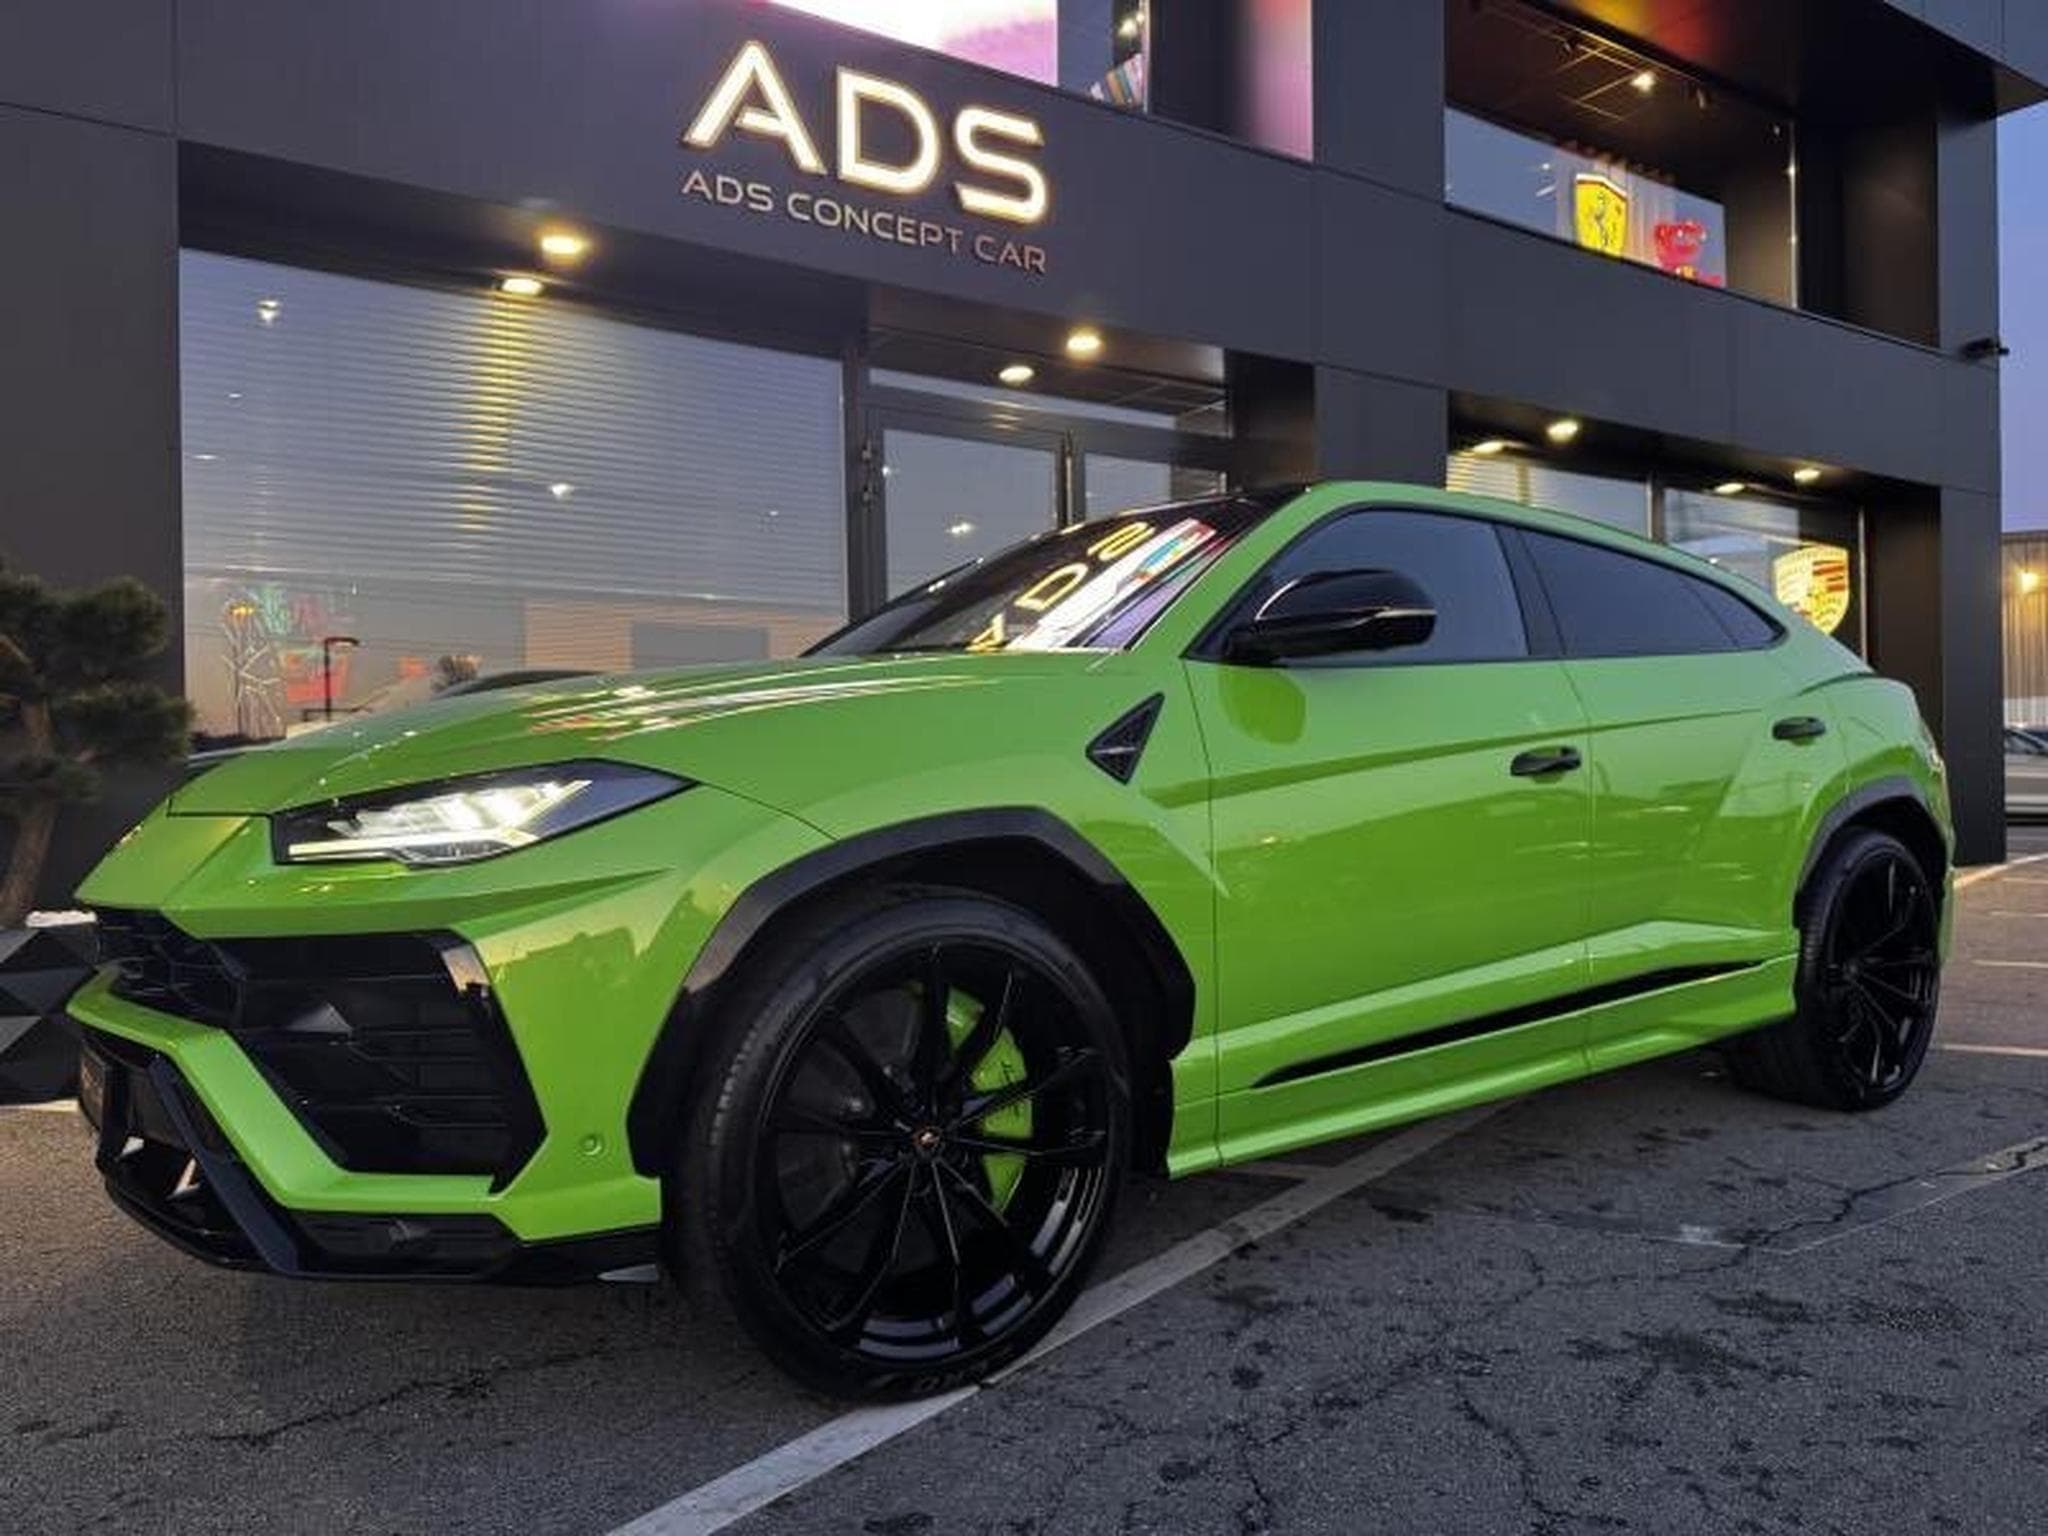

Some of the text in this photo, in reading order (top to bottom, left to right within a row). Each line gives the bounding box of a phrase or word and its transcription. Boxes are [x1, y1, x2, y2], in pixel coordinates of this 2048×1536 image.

[682, 40, 1049, 224] ADS
[681, 170, 1046, 274] ADS CONCEPT CAR
